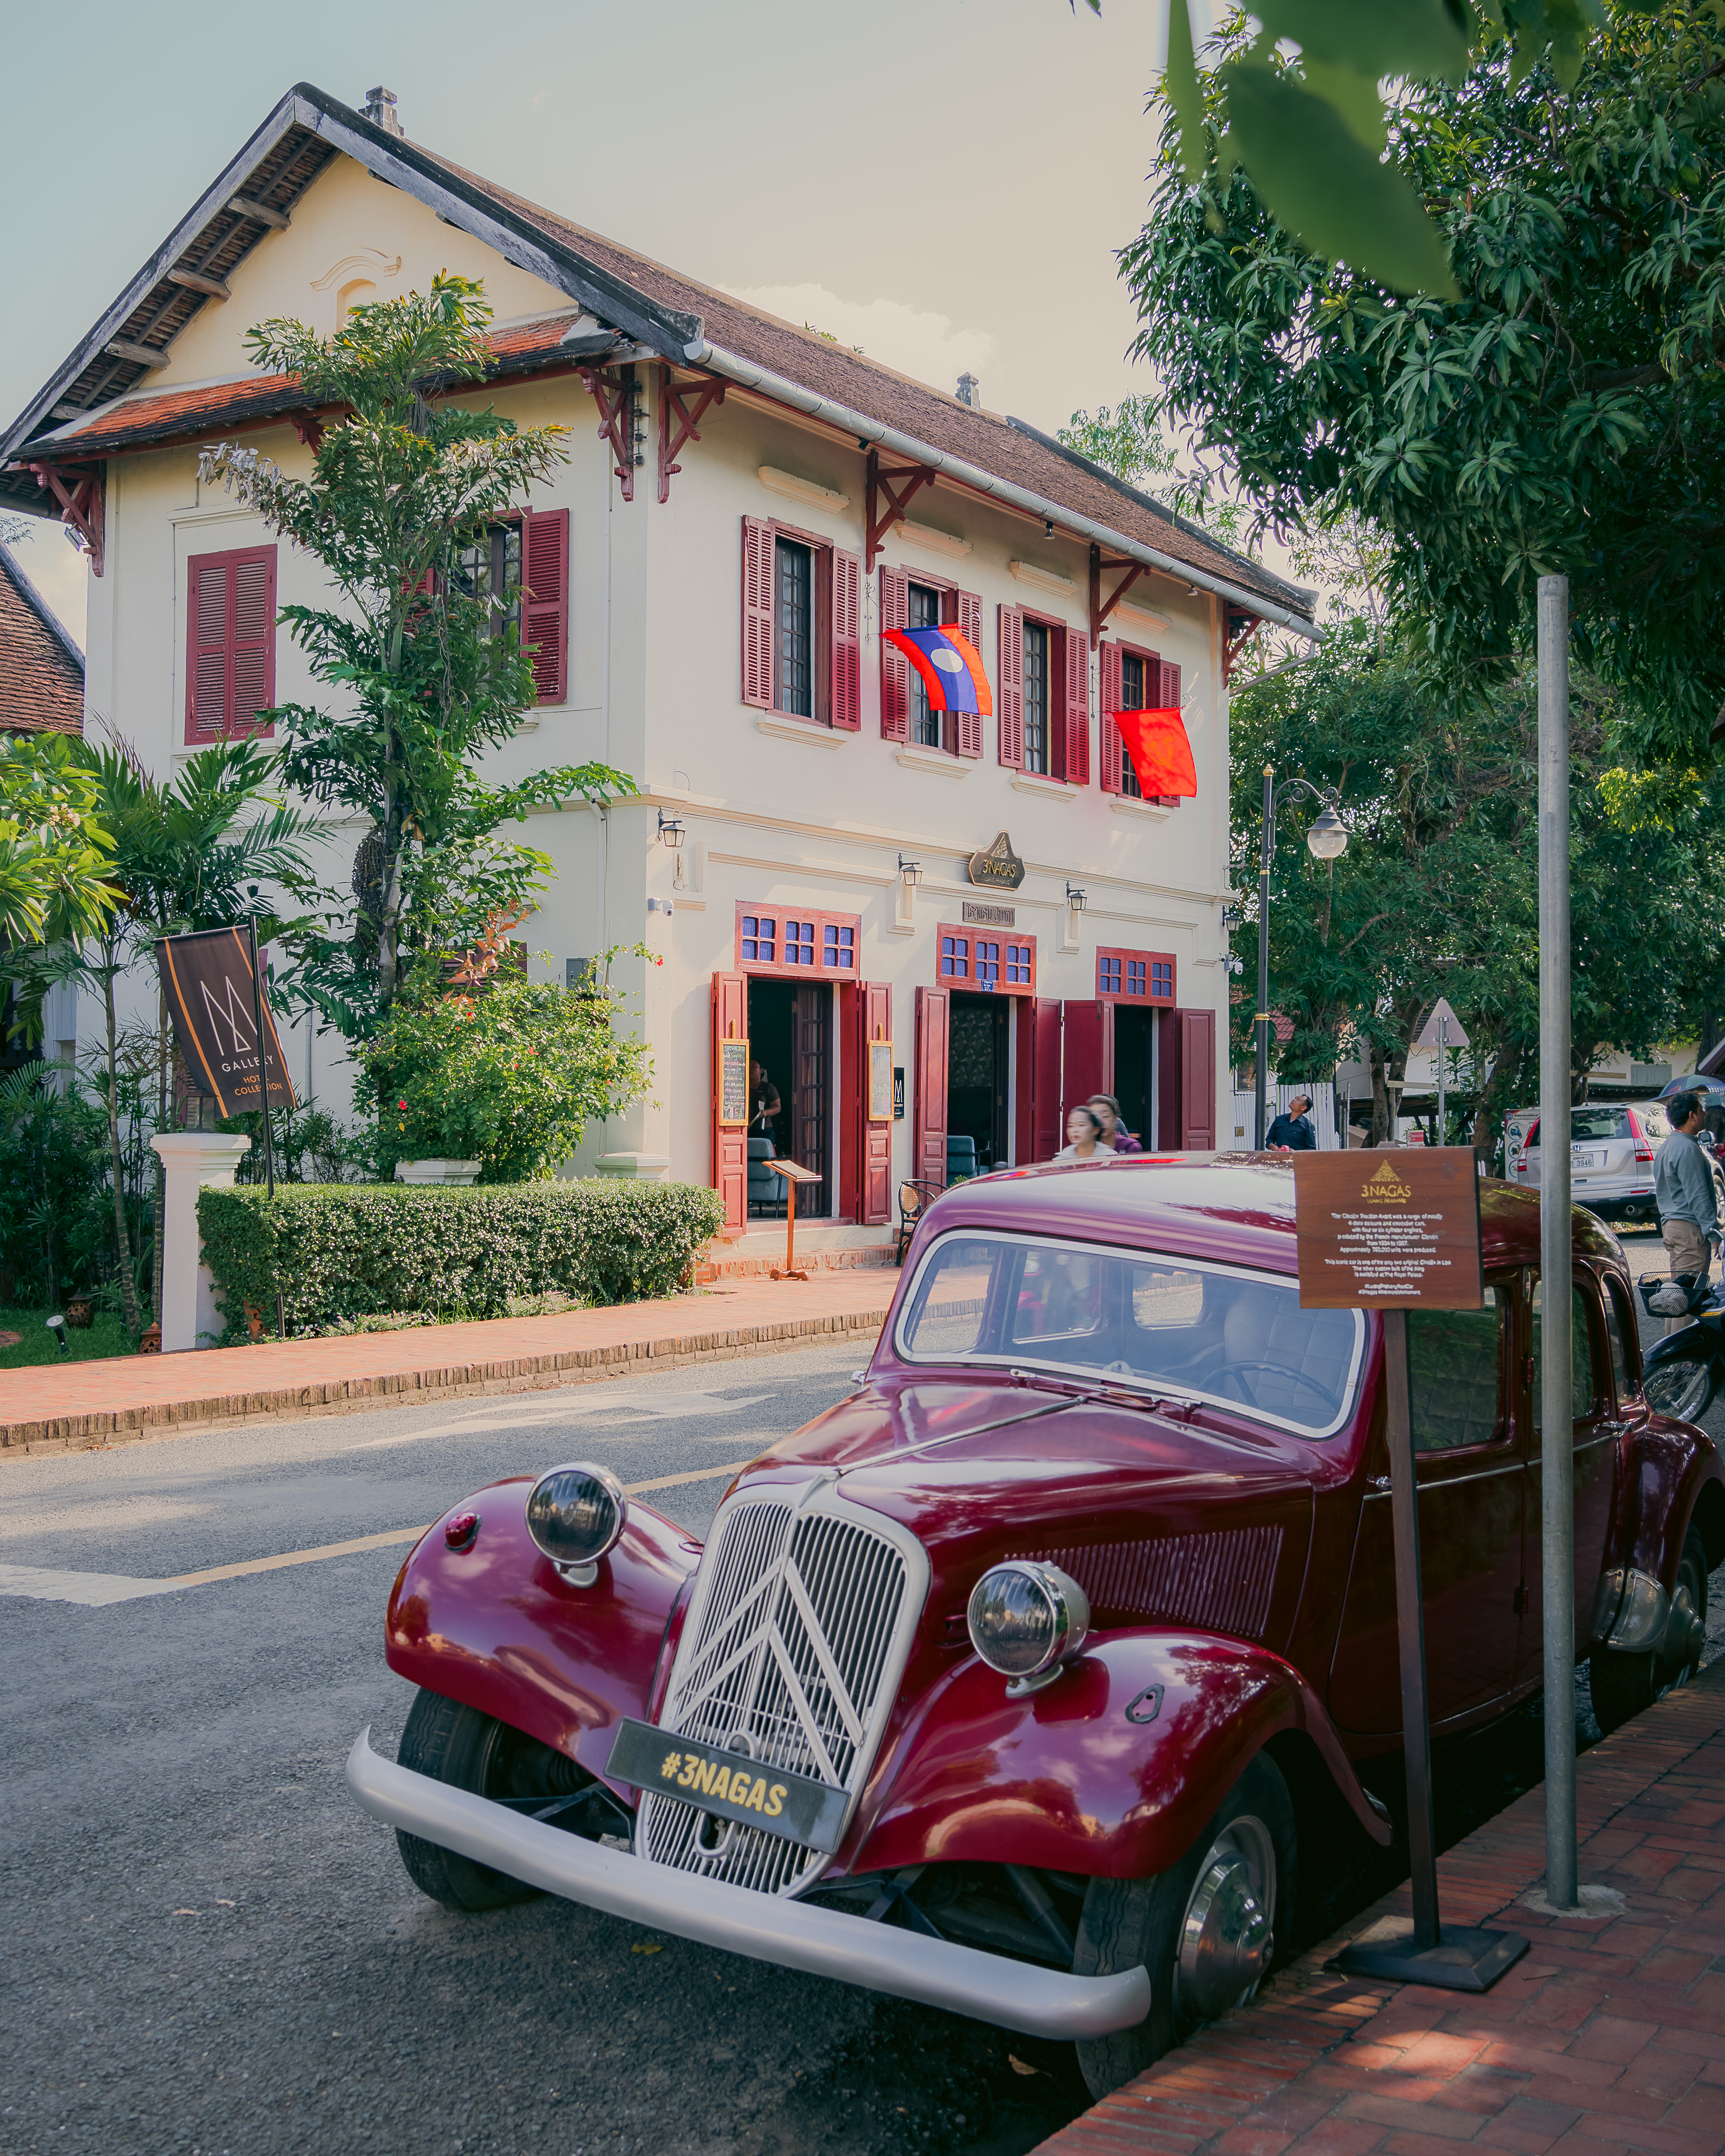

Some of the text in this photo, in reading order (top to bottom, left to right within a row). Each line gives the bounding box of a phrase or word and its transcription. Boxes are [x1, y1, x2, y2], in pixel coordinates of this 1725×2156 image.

[983, 860, 1016, 877] 3NAGAS
[243, 1075, 269, 1083] HOT
[235, 1083, 283, 1096] COLLETION
[1361, 1184, 1412, 1197] 3NAGAS
[661, 1752, 788, 1816] #3NAGAS
